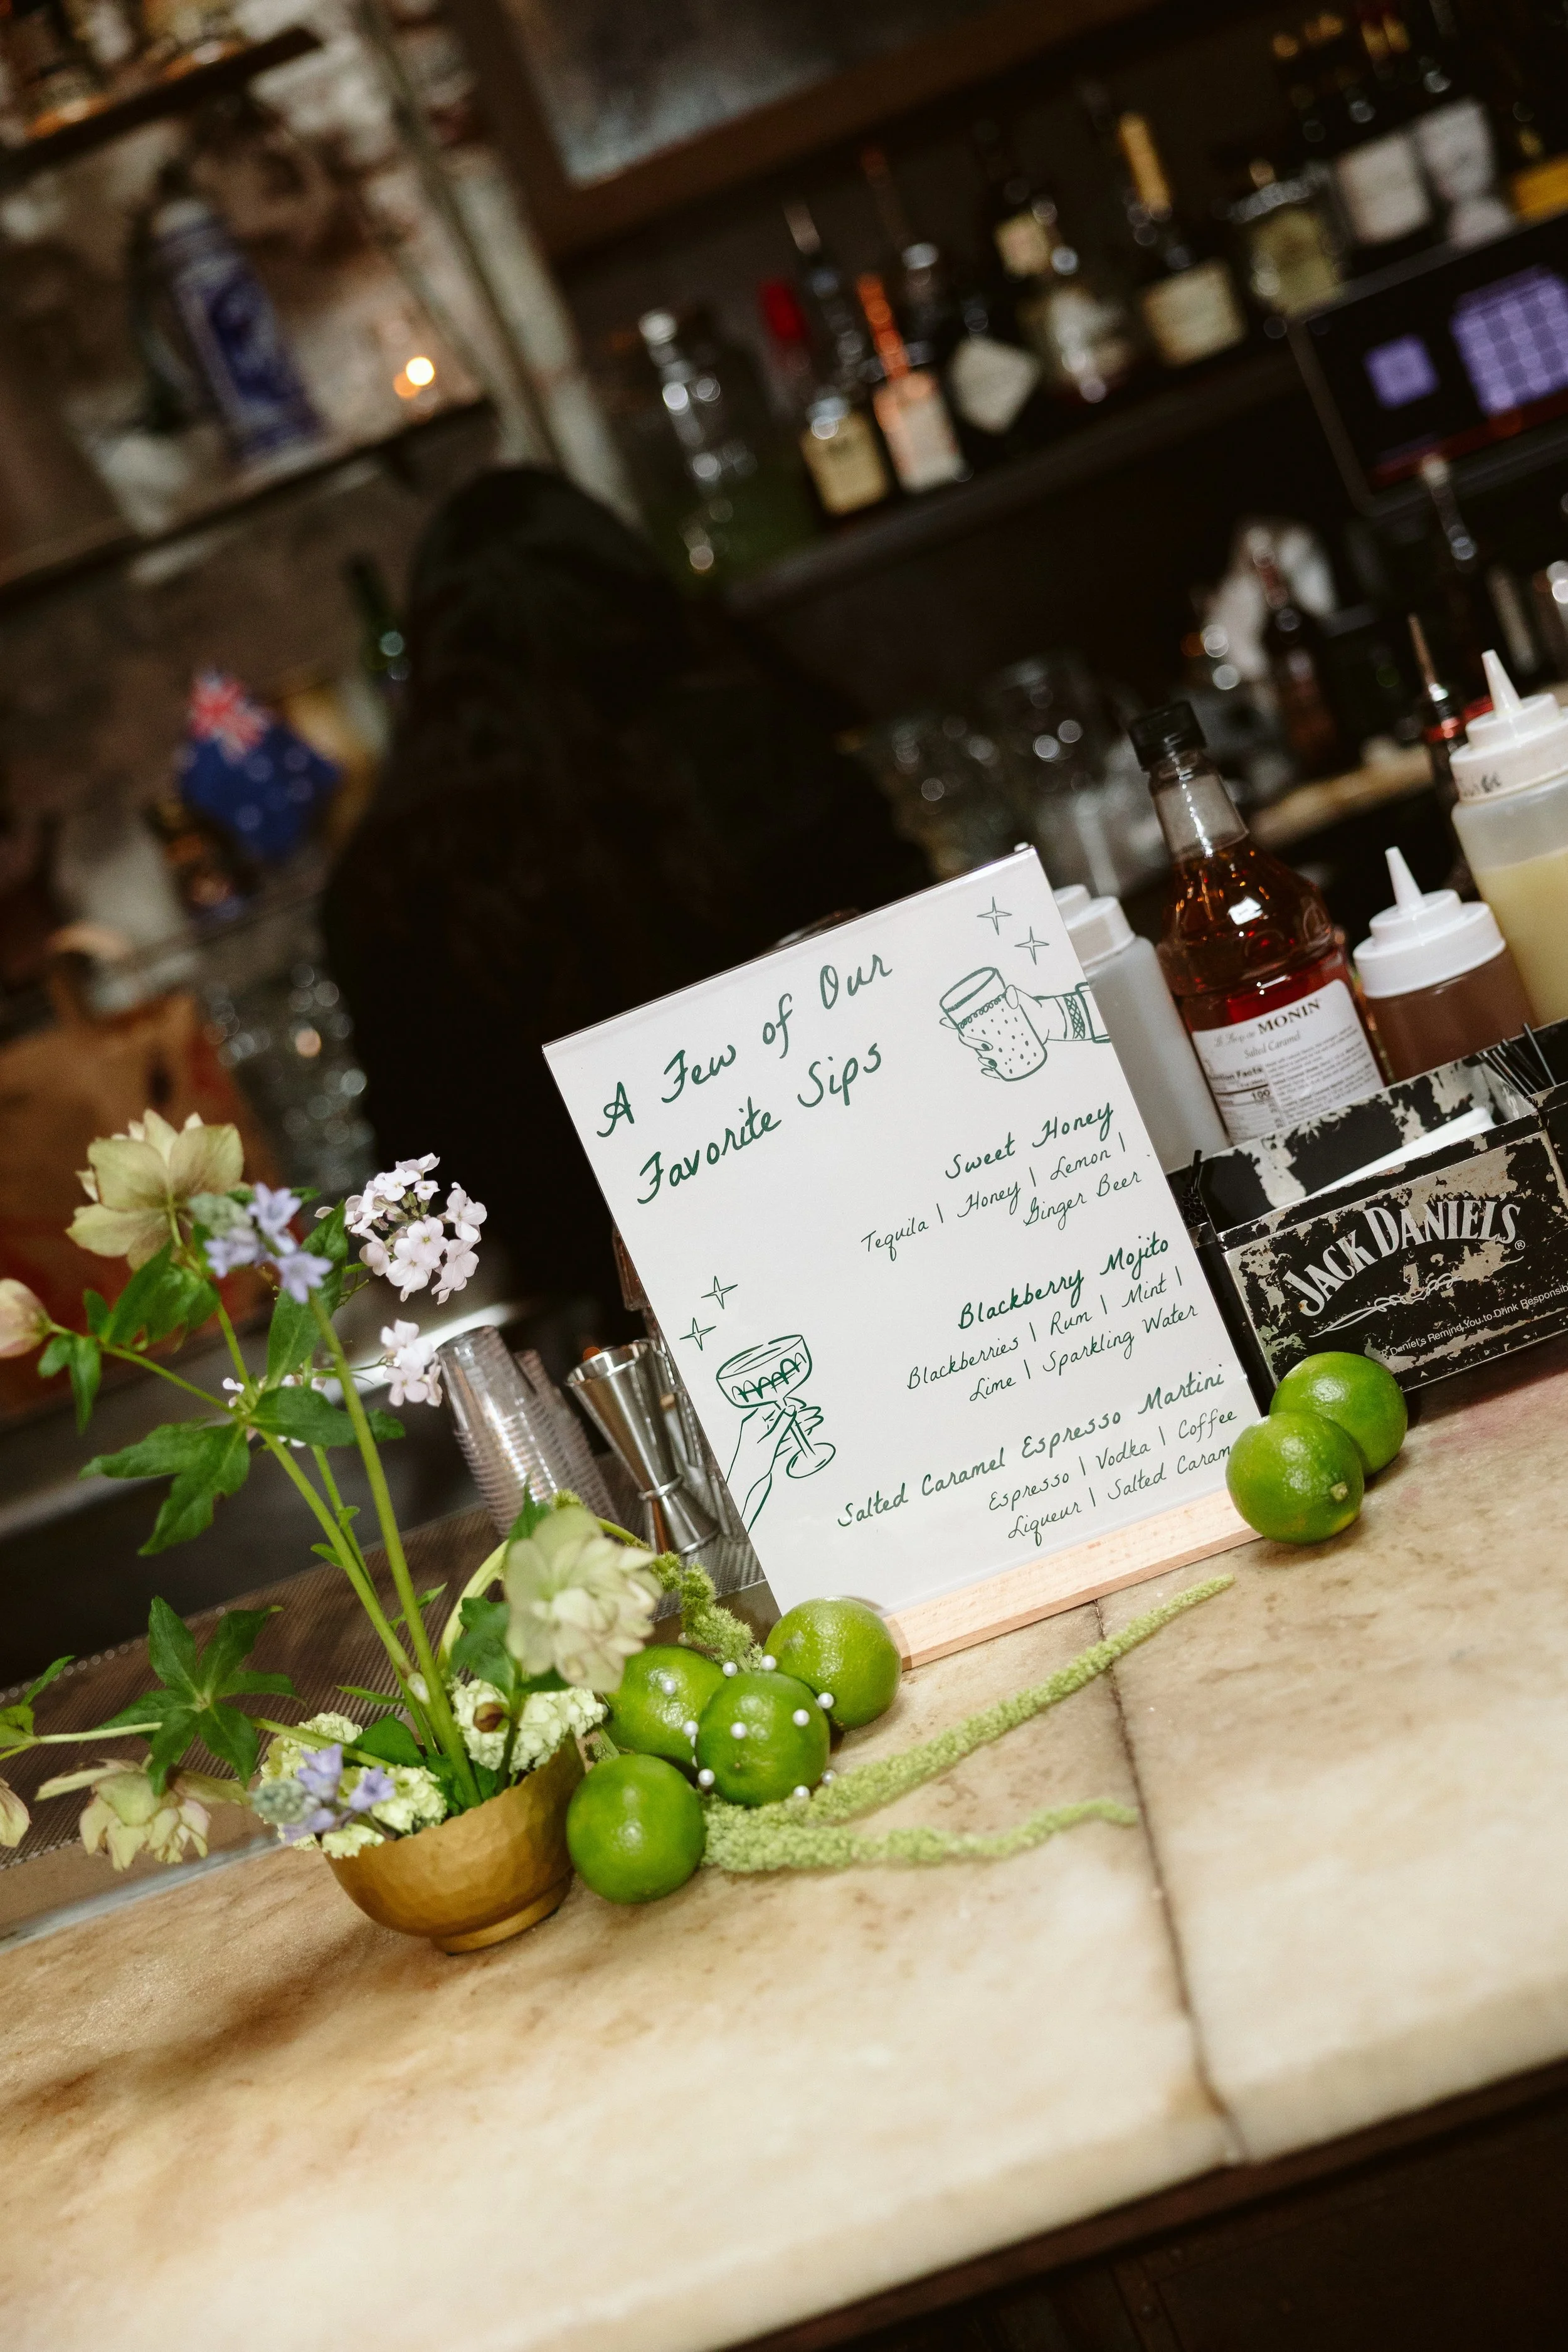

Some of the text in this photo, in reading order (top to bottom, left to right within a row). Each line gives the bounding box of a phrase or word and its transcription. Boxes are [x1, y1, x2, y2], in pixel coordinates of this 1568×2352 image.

[596, 954, 893, 1138] A Few of Our
[1244, 1042, 1267, 1059] Salted
[1268, 1029, 1301, 1051] Caramel
[1257, 998, 1321, 1034] MONIN
[637, 1042, 881, 1204] Favorite Sips
[945, 1103, 1113, 1179] Sweet Honey
[861, 1217, 929, 1261] Tequila
[957, 1182, 1021, 1217] Honey
[1050, 1150, 1111, 1180] Lemon
[1023, 1172, 1142, 1230] Ginger Beer
[958, 1231, 1168, 1329] Blackberry Mojito
[1282, 1229, 1379, 1316] JACK
[907, 1337, 1018, 1389] Blackberries
[1051, 1311, 1093, 1335] Rum
[1121, 1273, 1168, 1308] Mint
[970, 1377, 1016, 1401] Lime
[1043, 1332, 1134, 1376] Sparkling
[1142, 1303, 1198, 1333] Water
[1427, 1323, 1462, 1343] Remind
[1463, 1316, 1482, 1330] You
[1483, 1313, 1493, 1321] to
[1493, 1304, 1518, 1317] Drink
[837, 1364, 1224, 1527] Salted Caramel Espresso Martini
[989, 1473, 1069, 1511] Espresso
[1096, 1439, 1151, 1469] Vodka
[1179, 1409, 1237, 1443] Coffee
[1008, 1502, 1082, 1547] Liqueur
[1108, 1463, 1167, 1500] Salted
[1177, 1446, 1230, 1474] Caram
